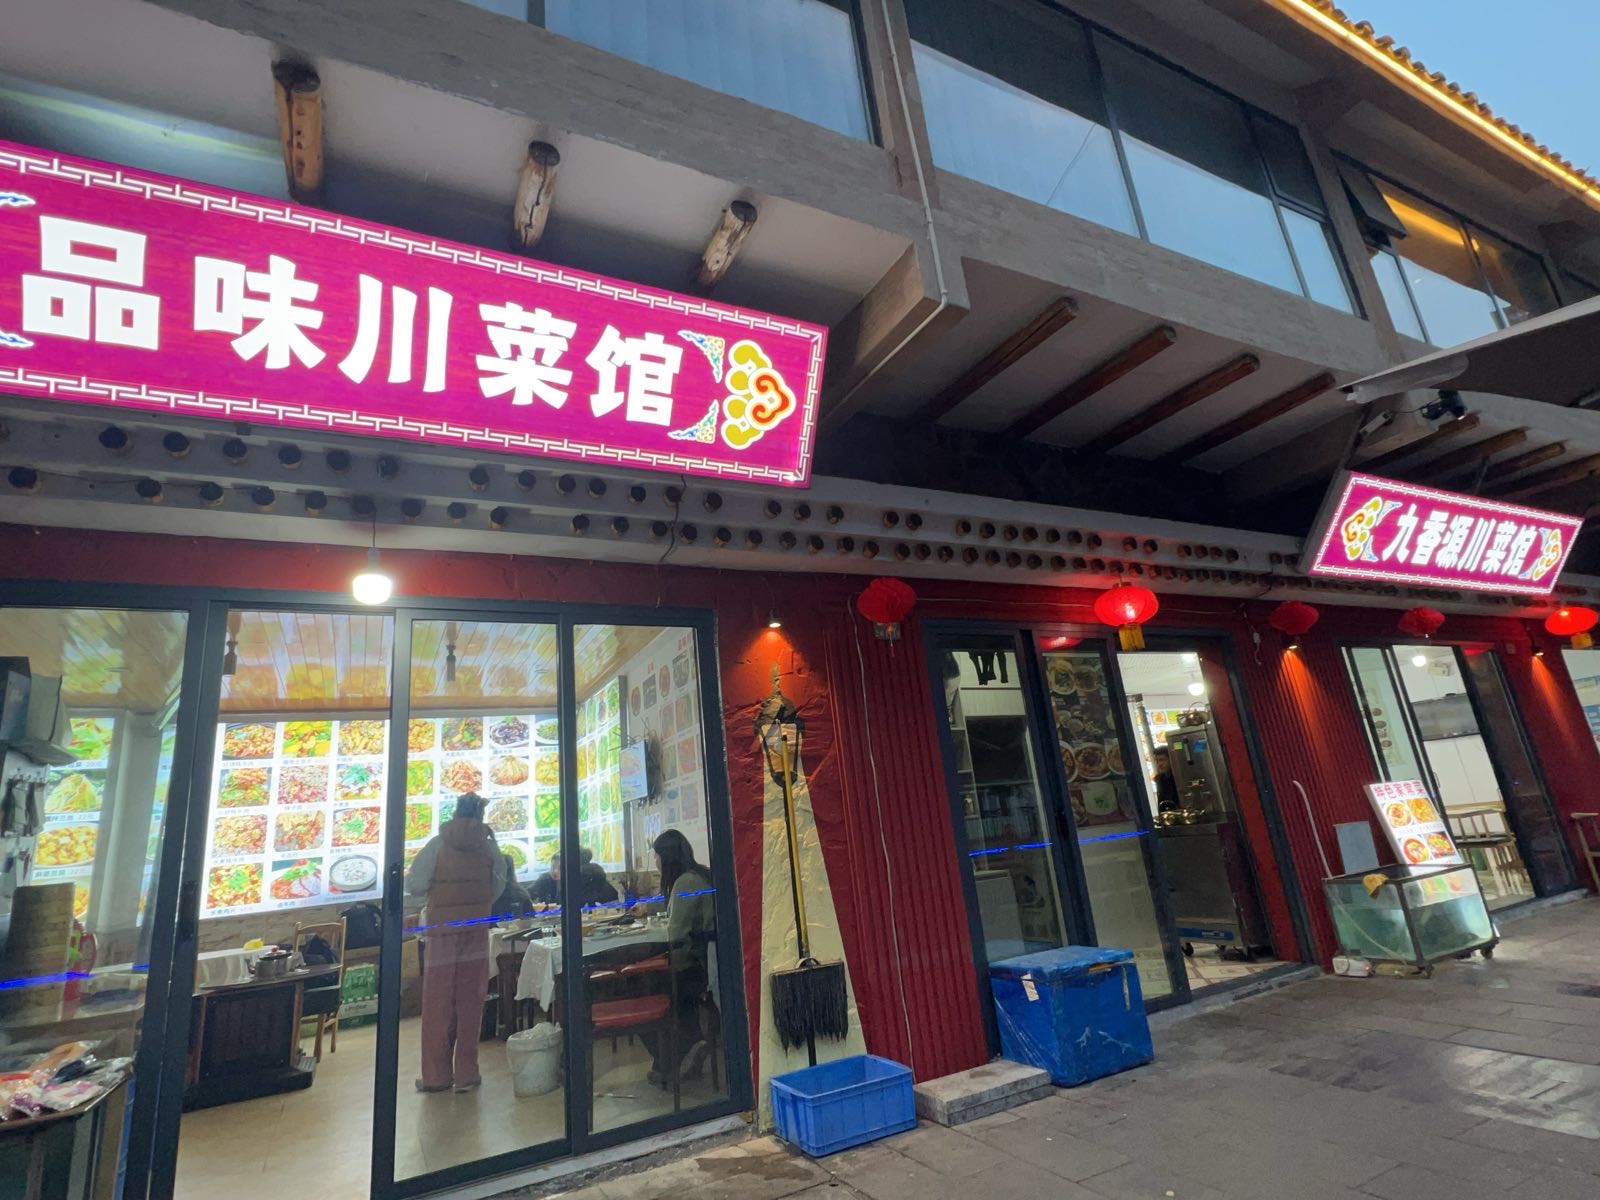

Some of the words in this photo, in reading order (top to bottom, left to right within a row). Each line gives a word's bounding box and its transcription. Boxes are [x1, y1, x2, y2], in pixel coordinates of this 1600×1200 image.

[22, 215, 683, 427] 品味川菜馆
